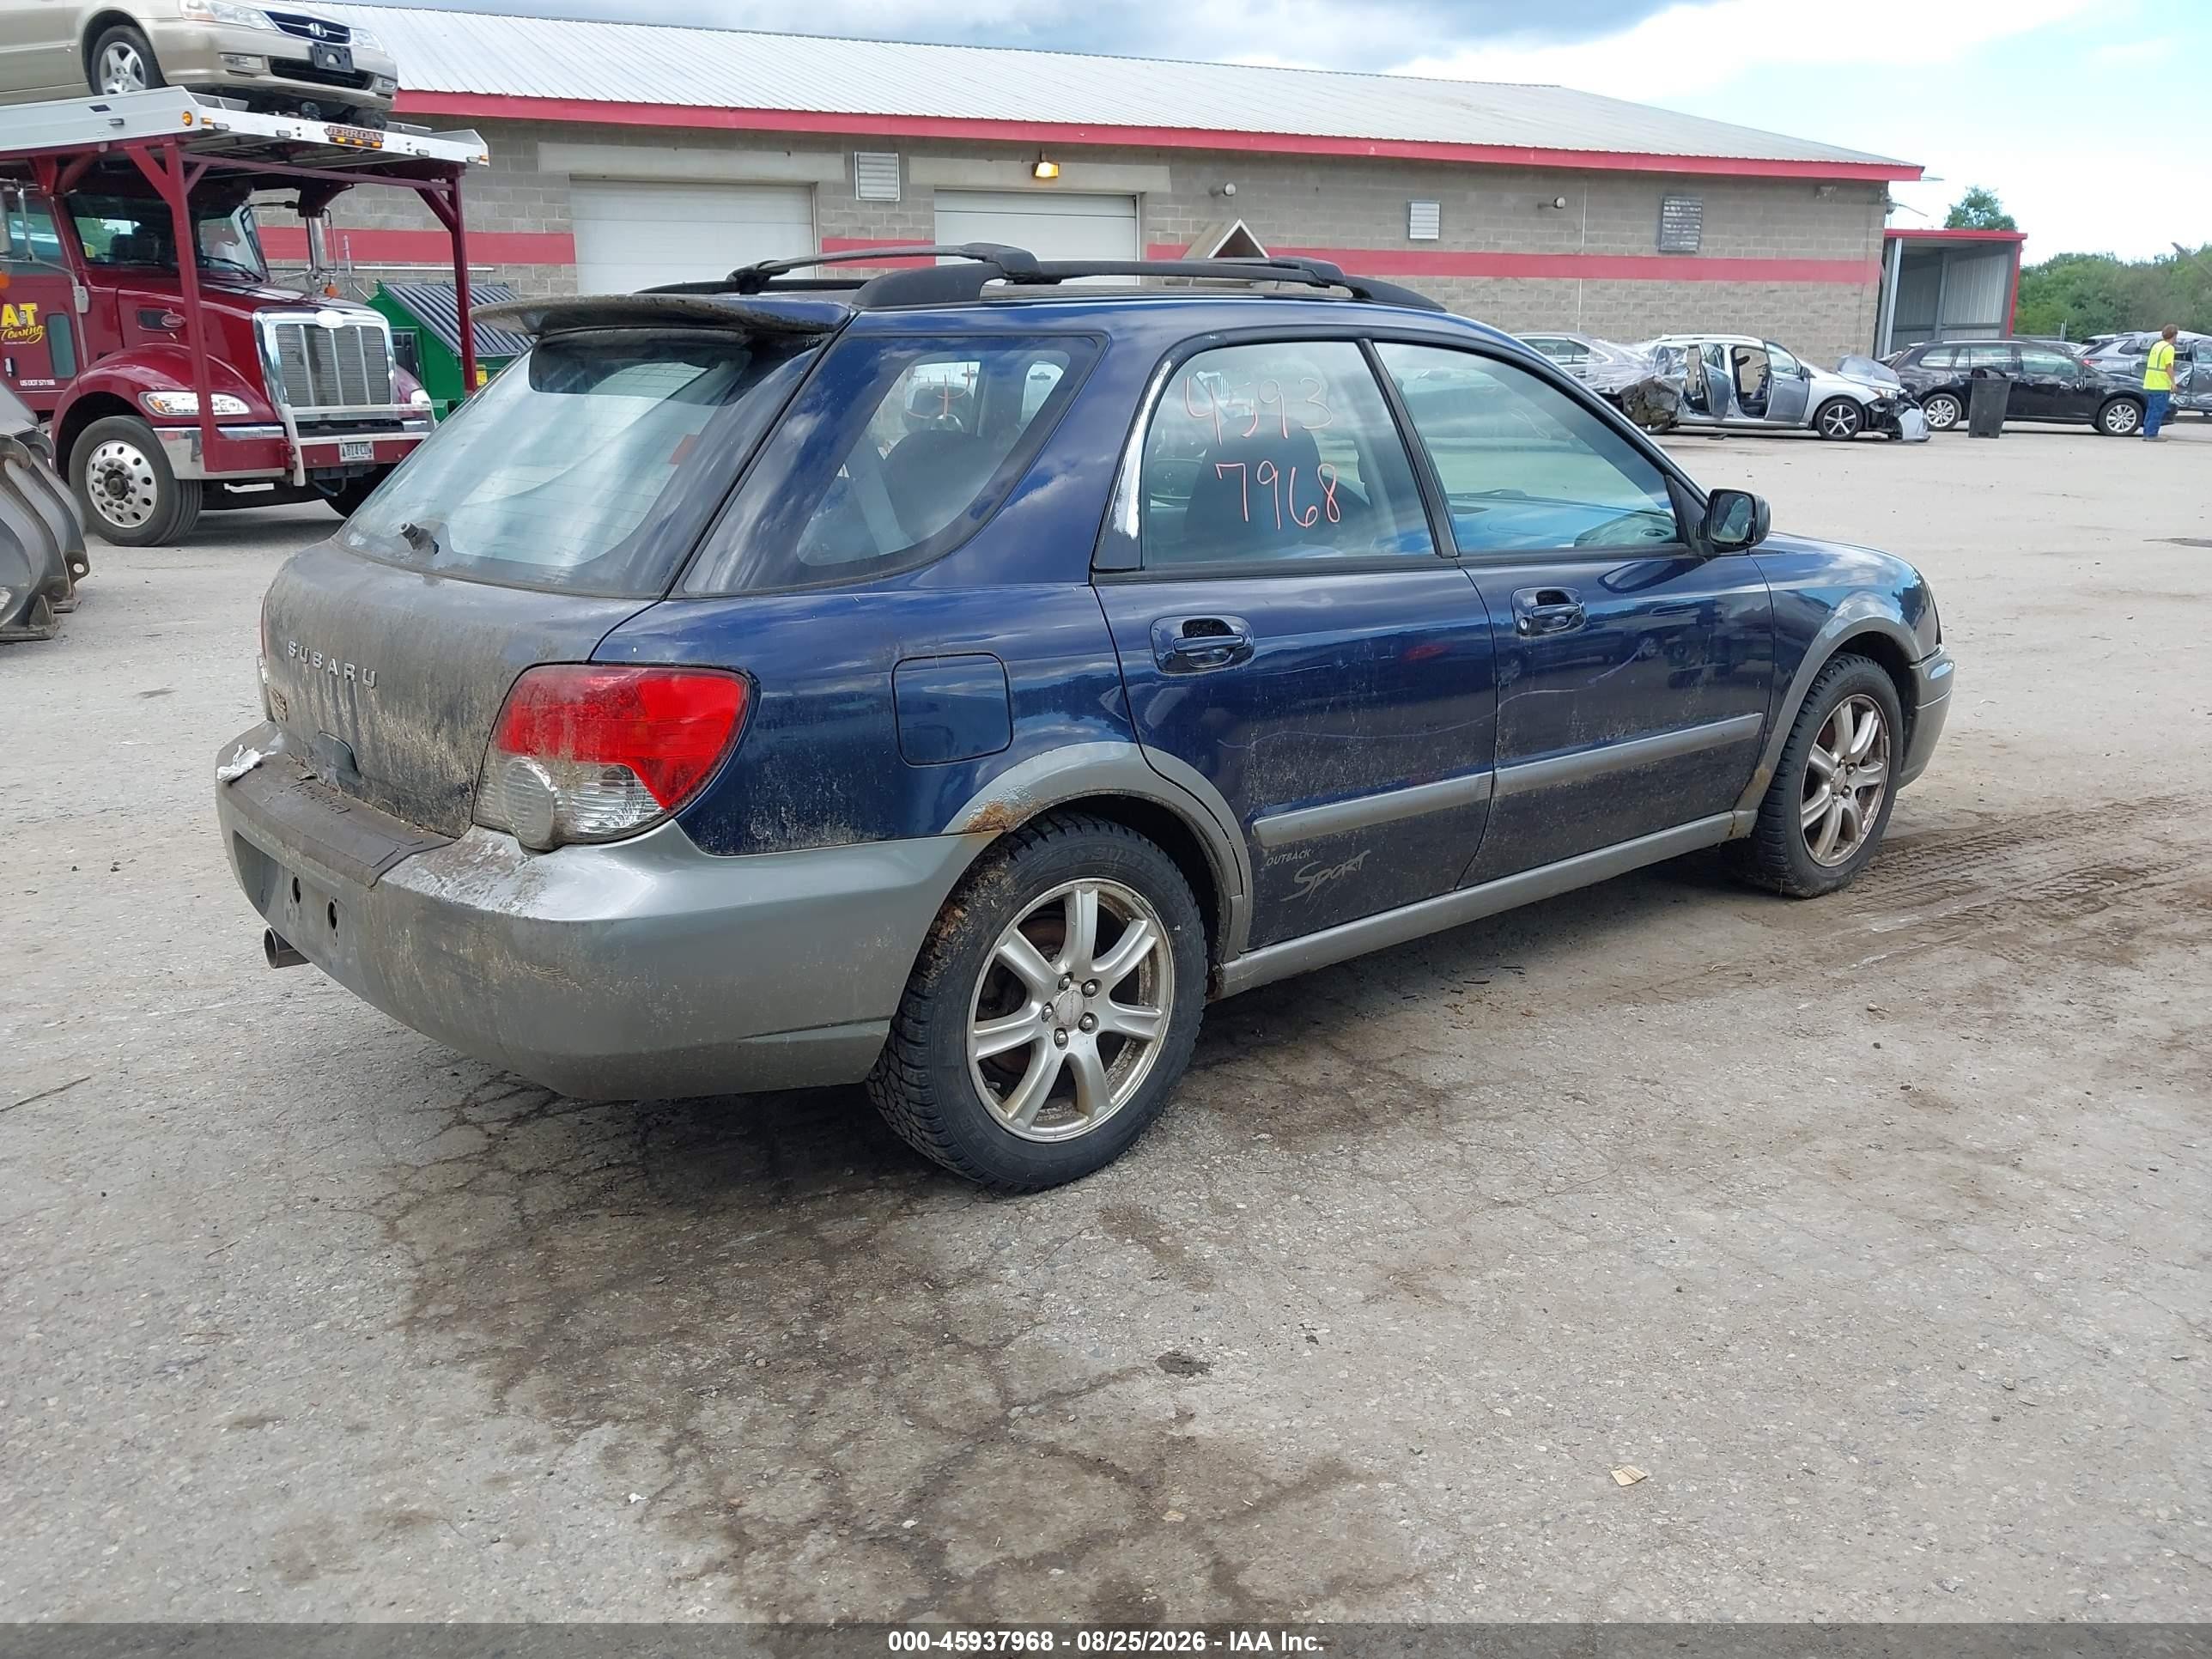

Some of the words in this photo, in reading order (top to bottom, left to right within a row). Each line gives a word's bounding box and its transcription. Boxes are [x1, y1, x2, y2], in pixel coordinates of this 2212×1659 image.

[325, 126, 384, 142] JERR-DAN
[0, 325, 44, 343] Towing
[1185, 376, 1333, 447] 4593
[1215, 459, 1340, 530] 7968
[287, 639, 378, 689] SUBARU
[1266, 848, 1311, 866] OUTBACK
